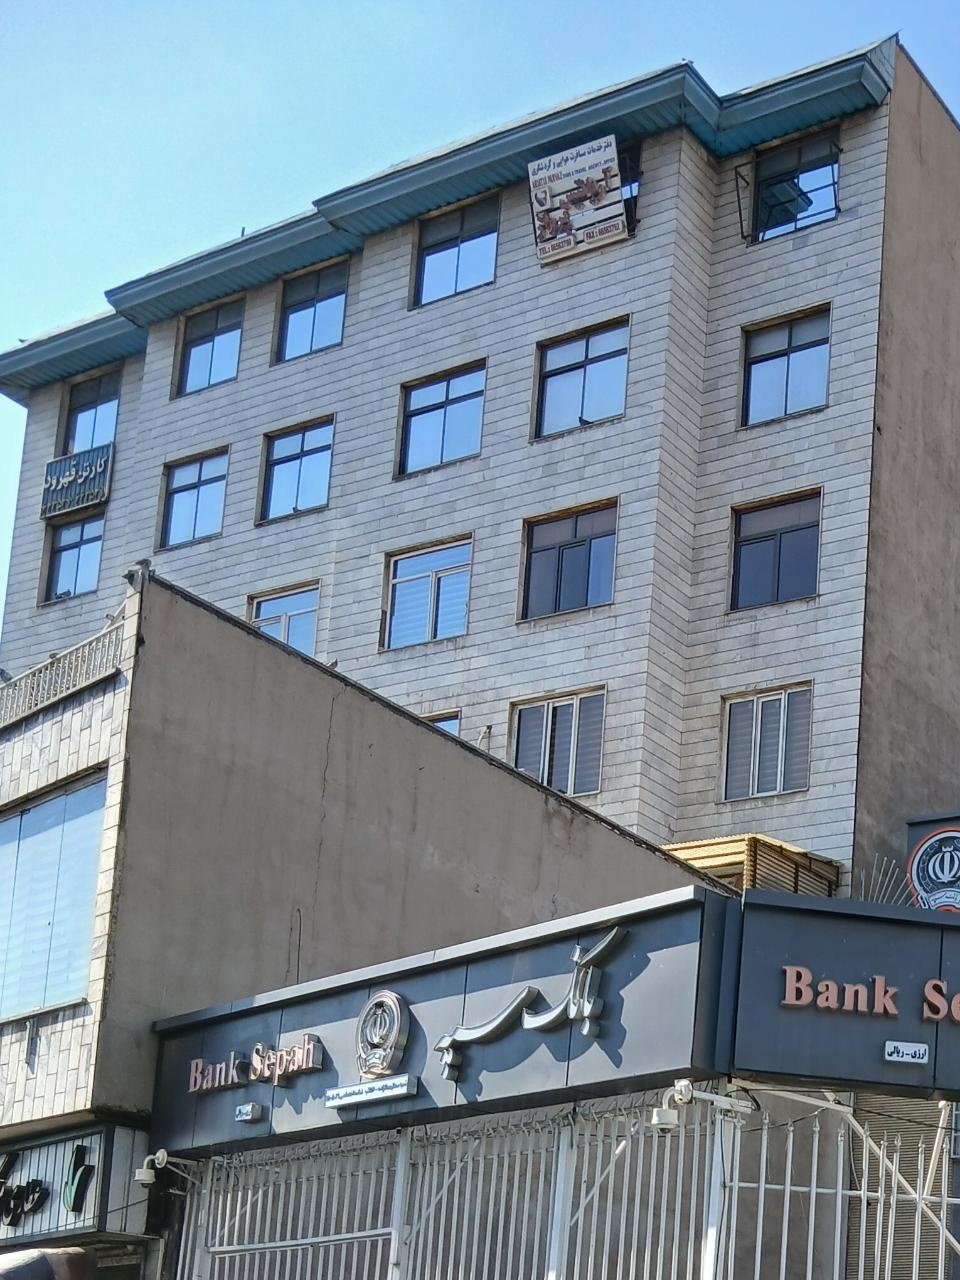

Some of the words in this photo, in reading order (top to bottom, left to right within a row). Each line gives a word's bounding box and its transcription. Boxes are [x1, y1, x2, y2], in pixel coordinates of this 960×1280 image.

[521, 926, 629, 1036] بانک
[781, 965, 899, 1016] Bank
[188, 1050, 247, 1093] Bank
[249, 1033, 322, 1086] Sepah
[434, 986, 543, 1080] سپه
